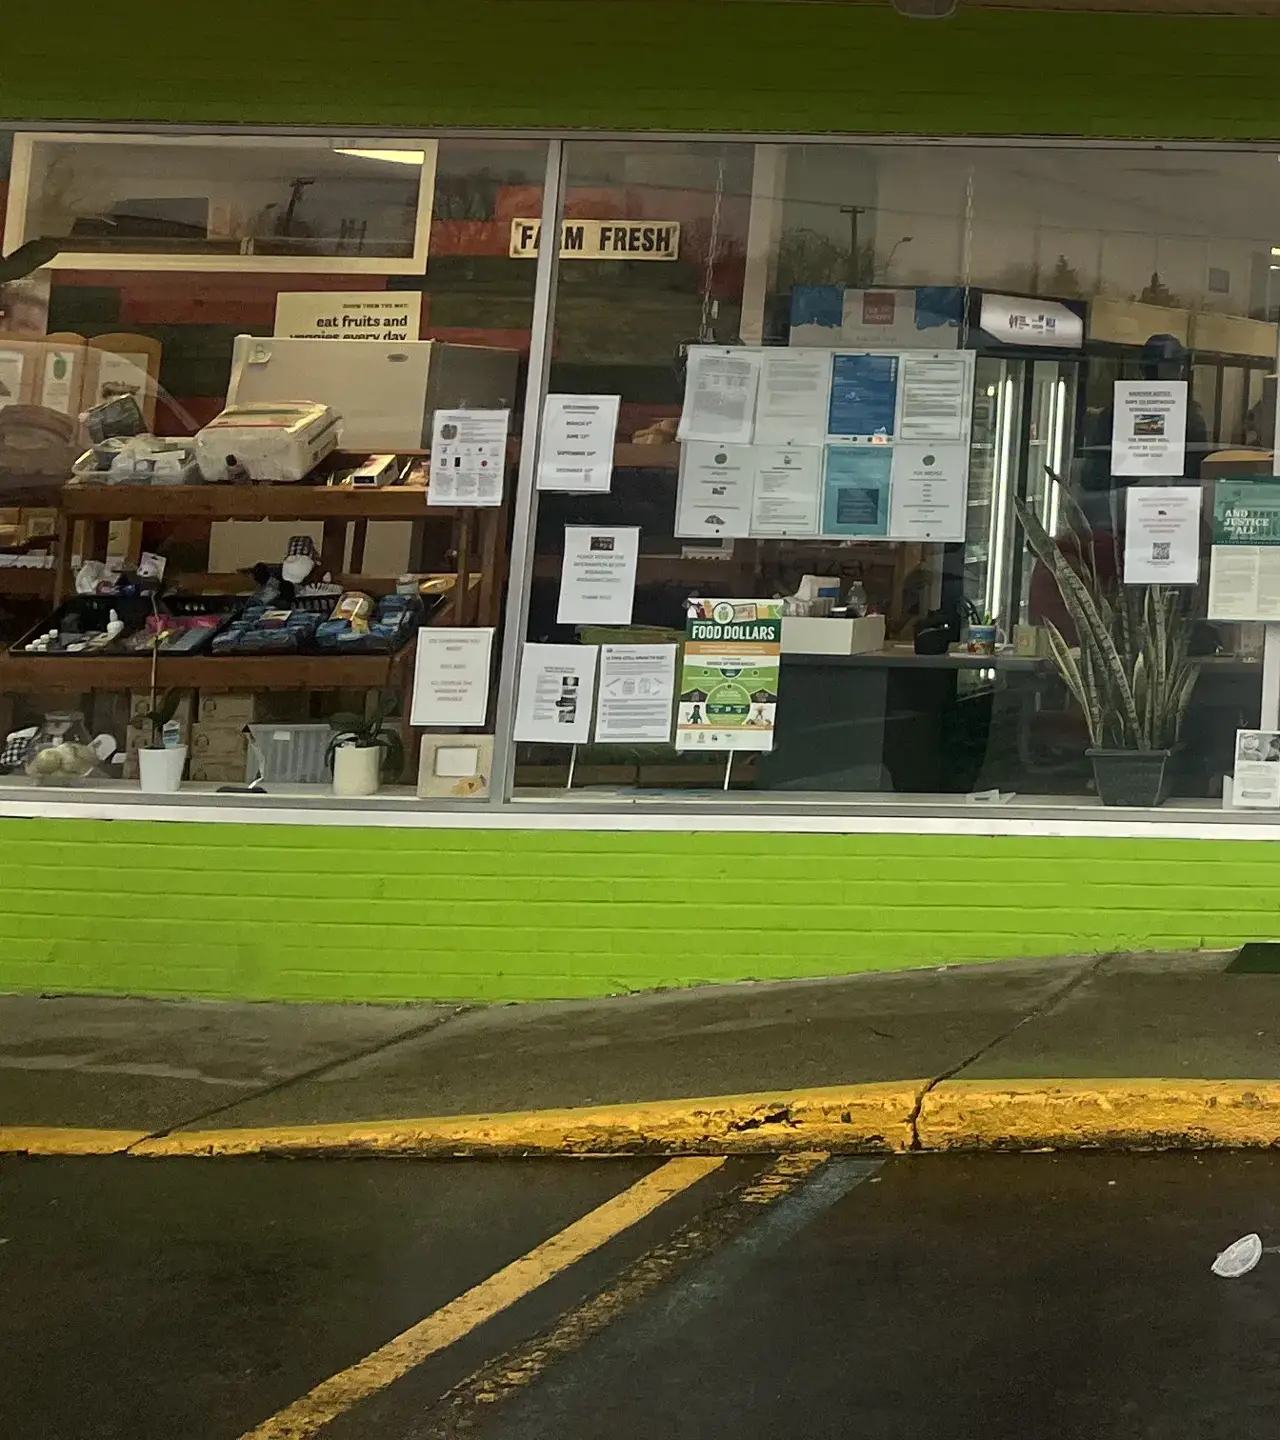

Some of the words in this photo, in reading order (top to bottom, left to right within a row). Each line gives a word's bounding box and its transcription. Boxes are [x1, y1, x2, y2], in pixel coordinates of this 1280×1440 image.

[520, 226, 585, 250] FM
[599, 227, 671, 252] FRESH
[316, 316, 339, 328] eat
[342, 314, 380, 328] fruits
[383, 314, 408, 327] and
[1224, 509, 1249, 518] AND
[1223, 518, 1270, 527] JUSTICE
[1235, 527, 1257, 535] ALL
[691, 625, 722, 640] FOOD
[723, 626, 775, 641] DOLLARS
